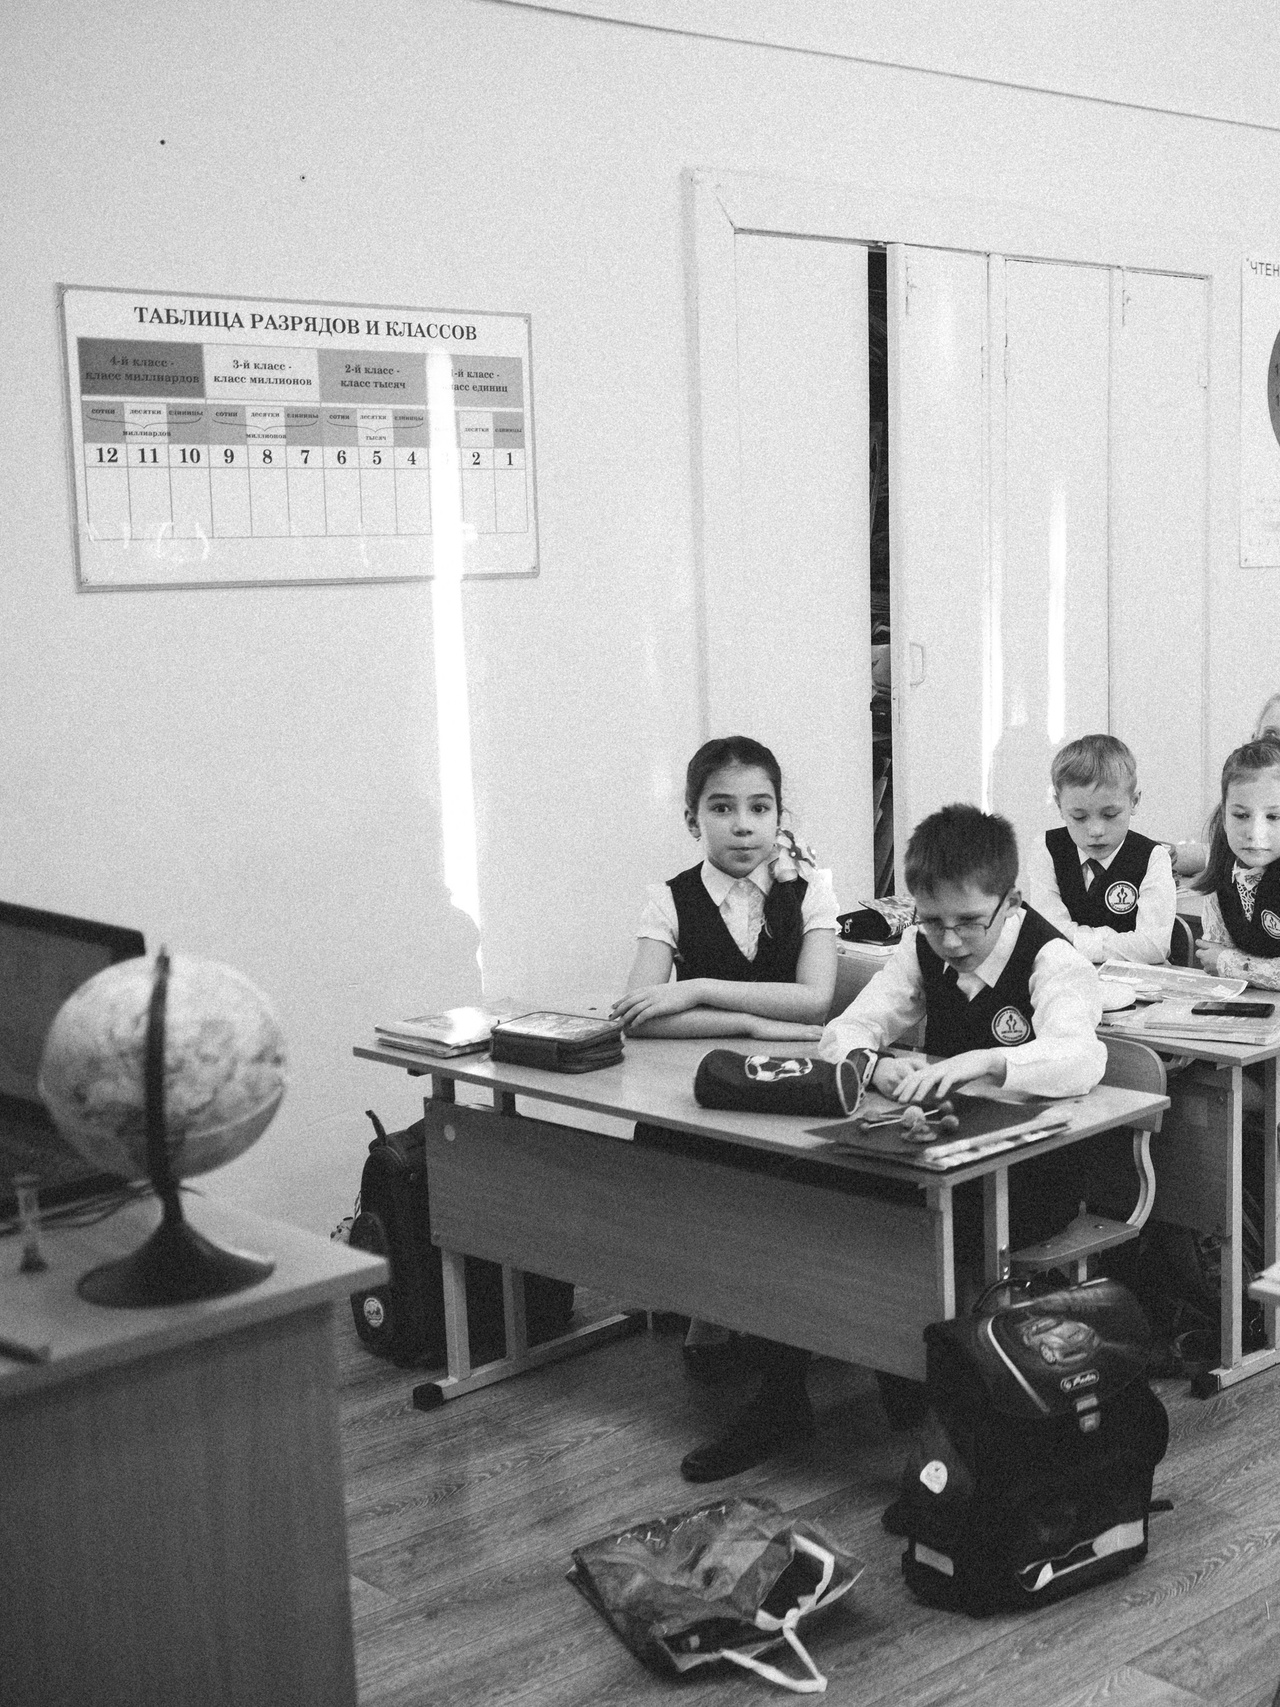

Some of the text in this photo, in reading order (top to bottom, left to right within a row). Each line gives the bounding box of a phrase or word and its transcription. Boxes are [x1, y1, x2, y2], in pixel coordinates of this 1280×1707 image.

[133, 306, 477, 340] ТАБЛИЦА РАЗРЯДОВ И КЛАССОВ
[132, 358, 168, 368] класс
[232, 359, 250, 370] 3-й
[253, 361, 287, 371] класс
[344, 364, 362, 375] 2-й
[364, 366, 394, 375] класс
[466, 370, 495, 379] класс
[85, 371, 200, 384] класс миллиардов
[213, 375, 312, 387] класс миллионов
[340, 379, 406, 389] класс тысяч
[472, 384, 508, 393] единиц
[96, 447, 514, 466] 12 11 10 9 8 7 6 5 4 2 1
